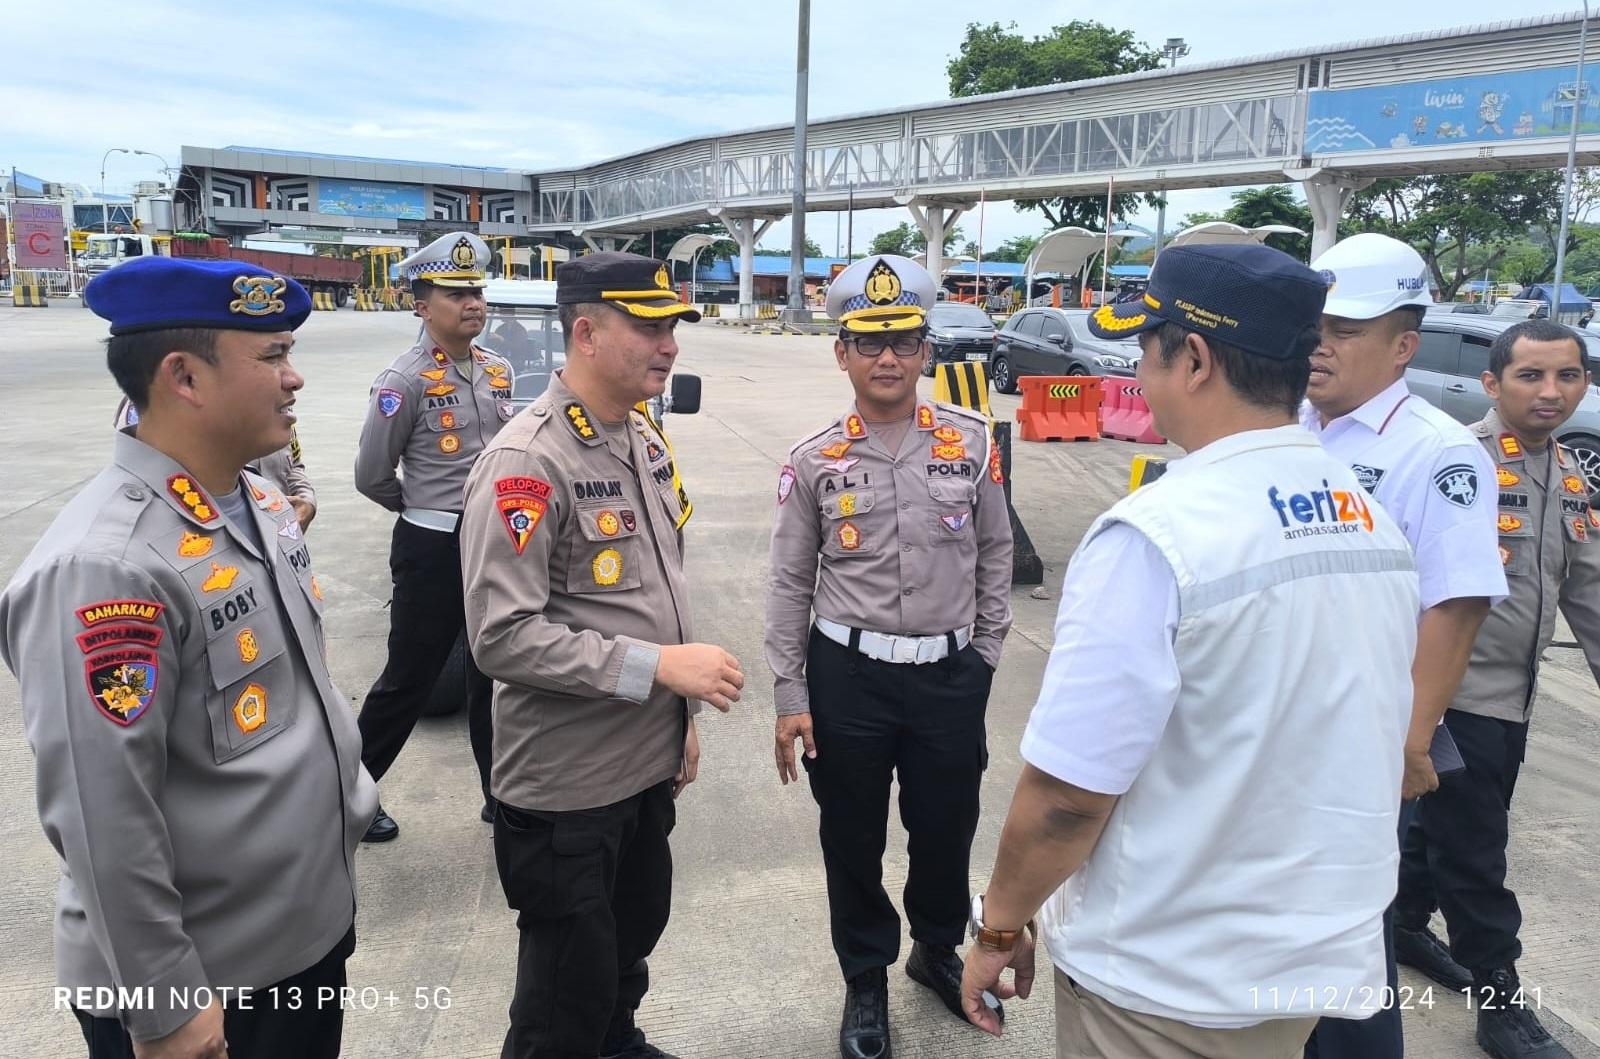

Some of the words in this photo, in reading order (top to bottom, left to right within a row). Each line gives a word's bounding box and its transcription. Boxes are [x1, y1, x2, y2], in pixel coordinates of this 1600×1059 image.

[28, 232, 50, 255] C
[428, 395, 460, 409] ADRI
[927, 464, 970, 477] POLRI
[499, 481, 547, 496] PELOPOR
[574, 481, 622, 499] DAULAY
[1268, 478, 1374, 533] ferizy
[1284, 523, 1360, 540] ambassador
[84, 603, 156, 622] BAHARKAM
[210, 587, 257, 631] BOBY
